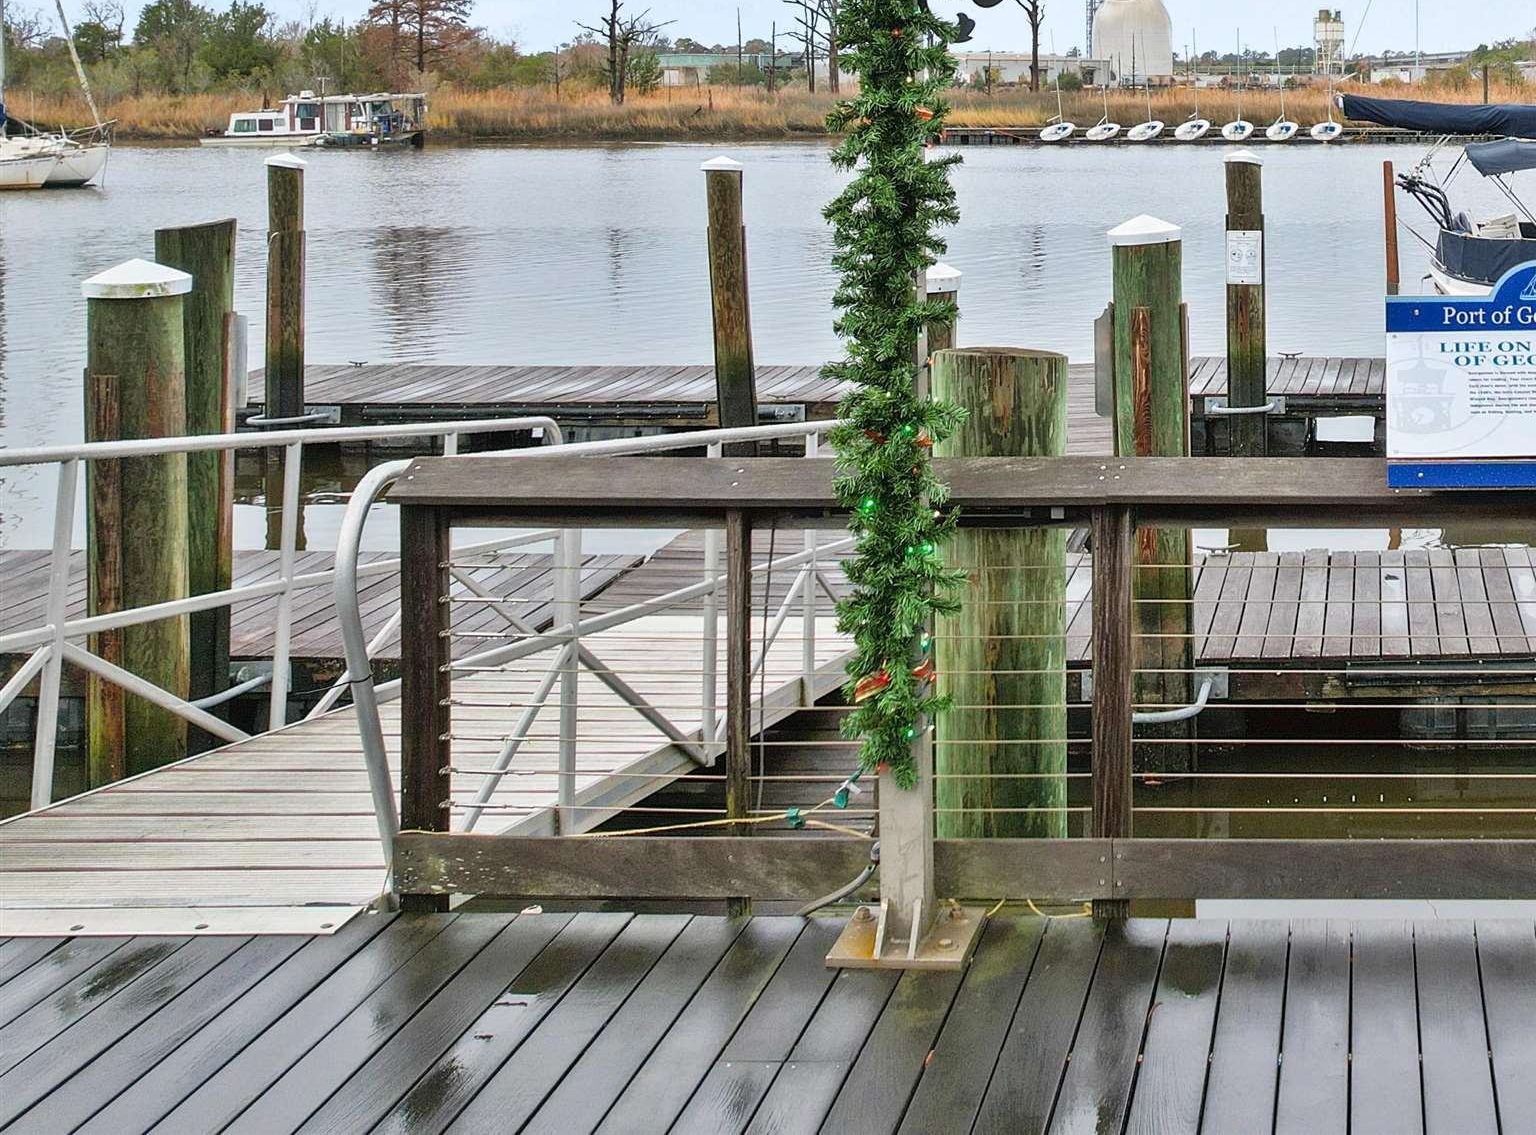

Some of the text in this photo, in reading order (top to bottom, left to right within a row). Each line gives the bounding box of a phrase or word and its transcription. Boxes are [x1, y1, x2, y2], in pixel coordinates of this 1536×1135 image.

[1442, 306, 1486, 324] Port
[1491, 305, 1513, 324] of
[1440, 341, 1492, 353] LIFE
[1498, 341, 1531, 352] ON
[1454, 355, 1486, 366] OF
